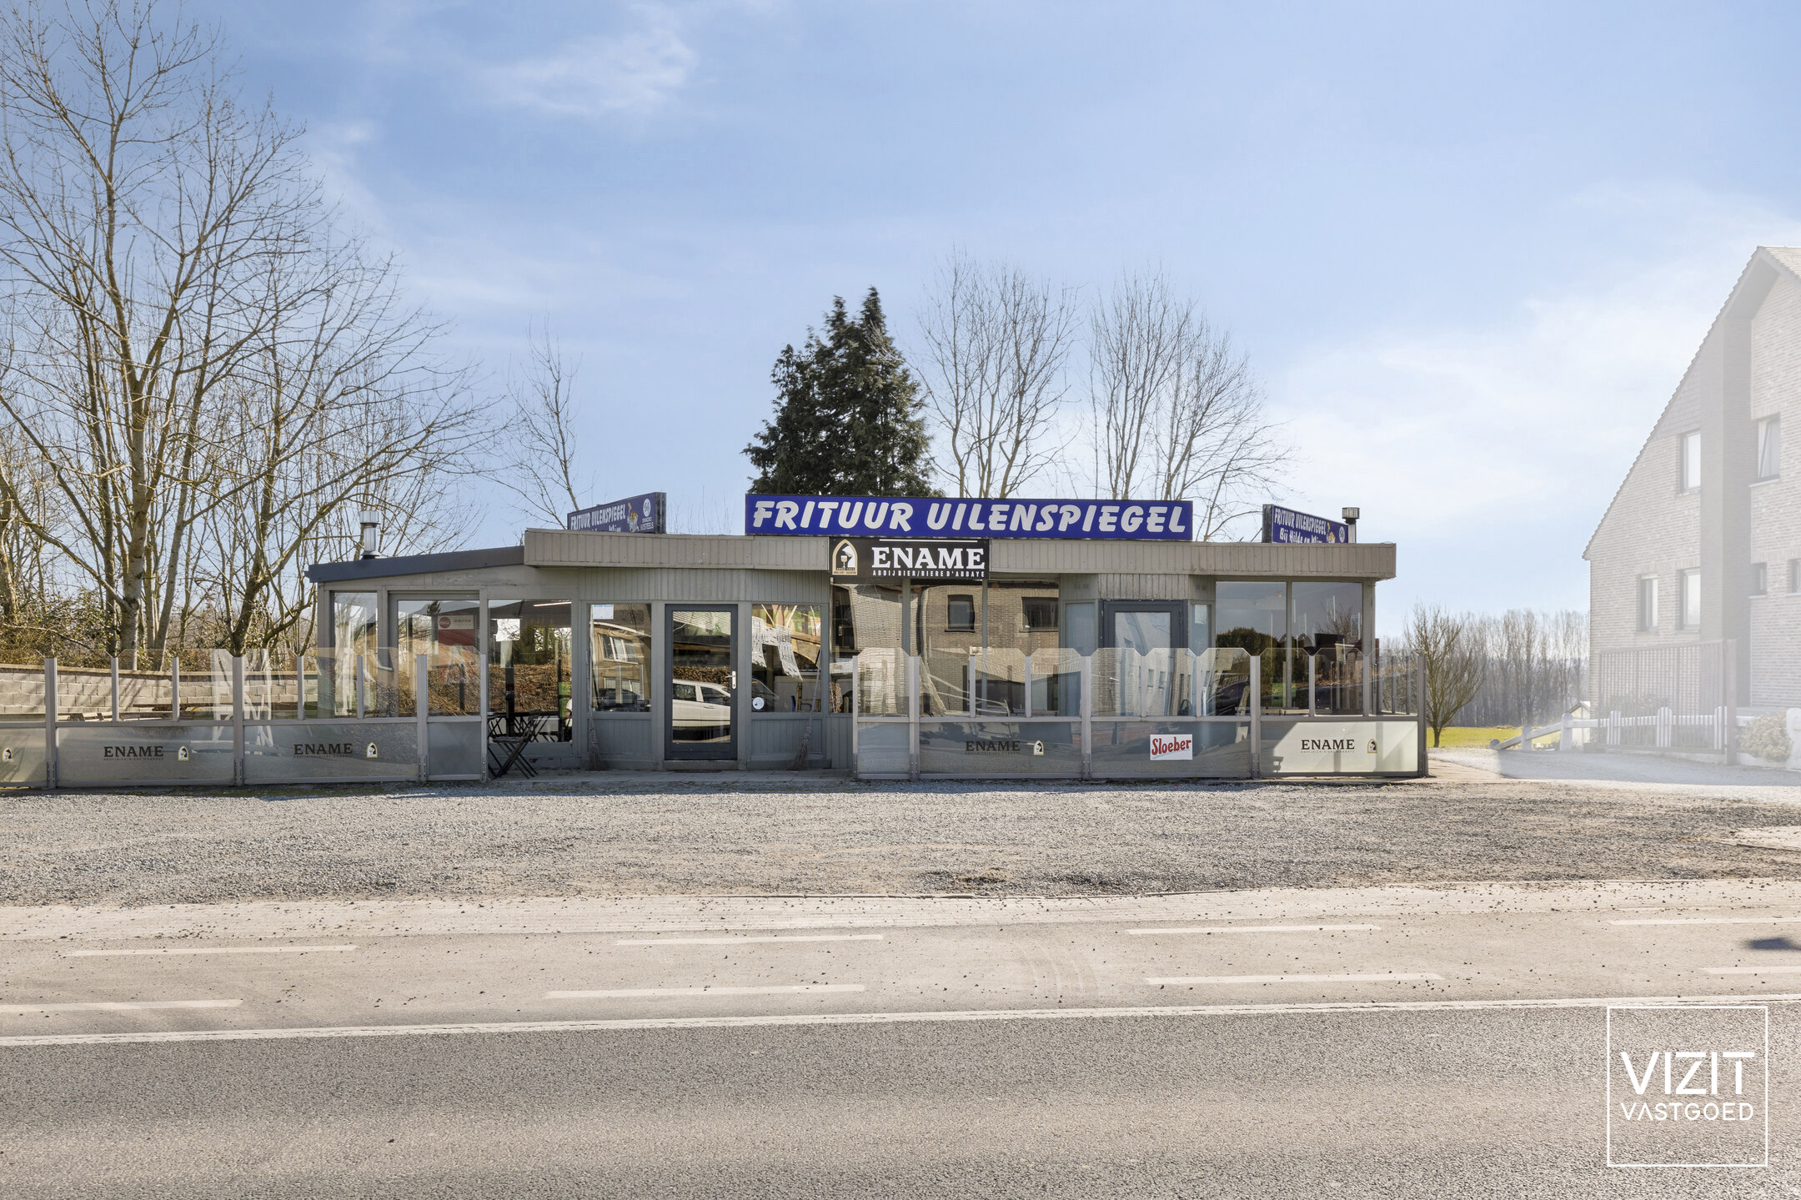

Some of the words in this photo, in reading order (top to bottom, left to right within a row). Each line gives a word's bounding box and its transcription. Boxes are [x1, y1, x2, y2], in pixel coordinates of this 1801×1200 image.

[571, 512, 591, 531] FRITUUR
[592, 504, 626, 526] UILENSPIEGEL
[752, 501, 914, 532] FRITUUR
[926, 503, 1188, 533] UILENSPIEGEL
[1274, 507, 1295, 529] FRITUUR
[1295, 514, 1327, 536] UILENSPIEGEL
[871, 547, 985, 570] ENAME
[103, 745, 164, 758] ENAME
[293, 742, 353, 755] ENAME
[965, 740, 1021, 752] ENAME
[1151, 736, 1192, 756] Sloeber
[1301, 739, 1355, 750] ENAME
